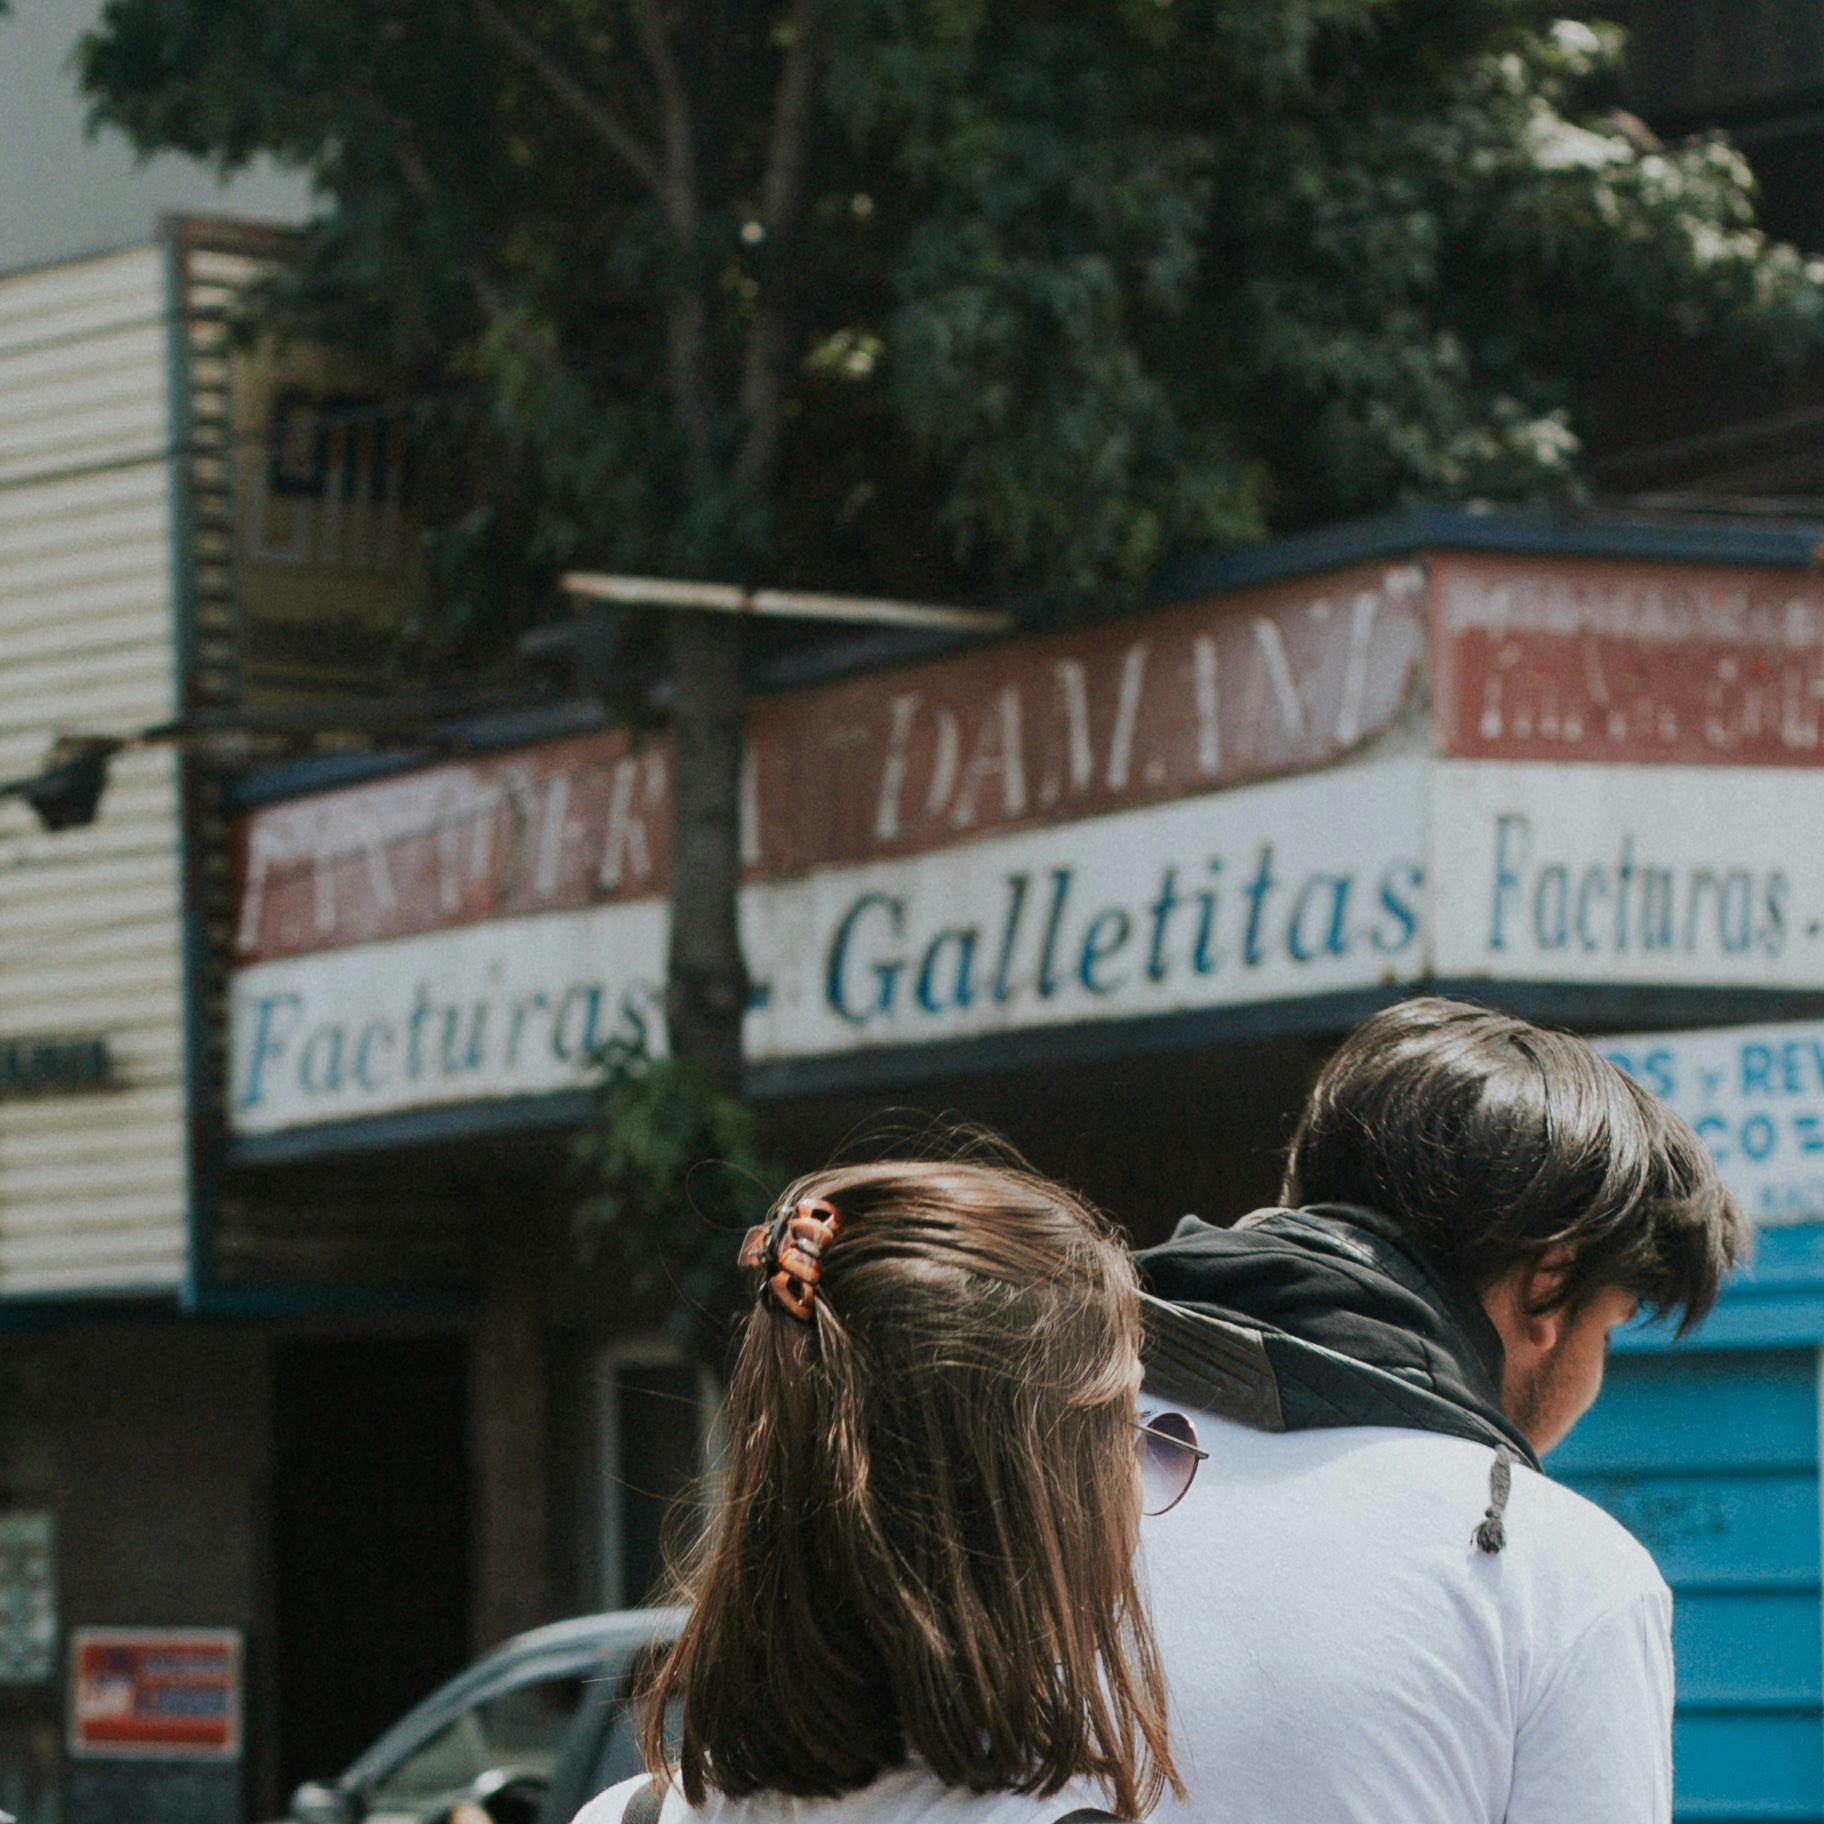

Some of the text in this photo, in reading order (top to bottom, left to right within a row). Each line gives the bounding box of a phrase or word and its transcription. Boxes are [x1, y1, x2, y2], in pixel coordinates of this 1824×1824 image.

[242, 980, 660, 1107] Facturas
[825, 844, 1424, 1026] Galletitas
[1487, 812, 1785, 957] Facturas
